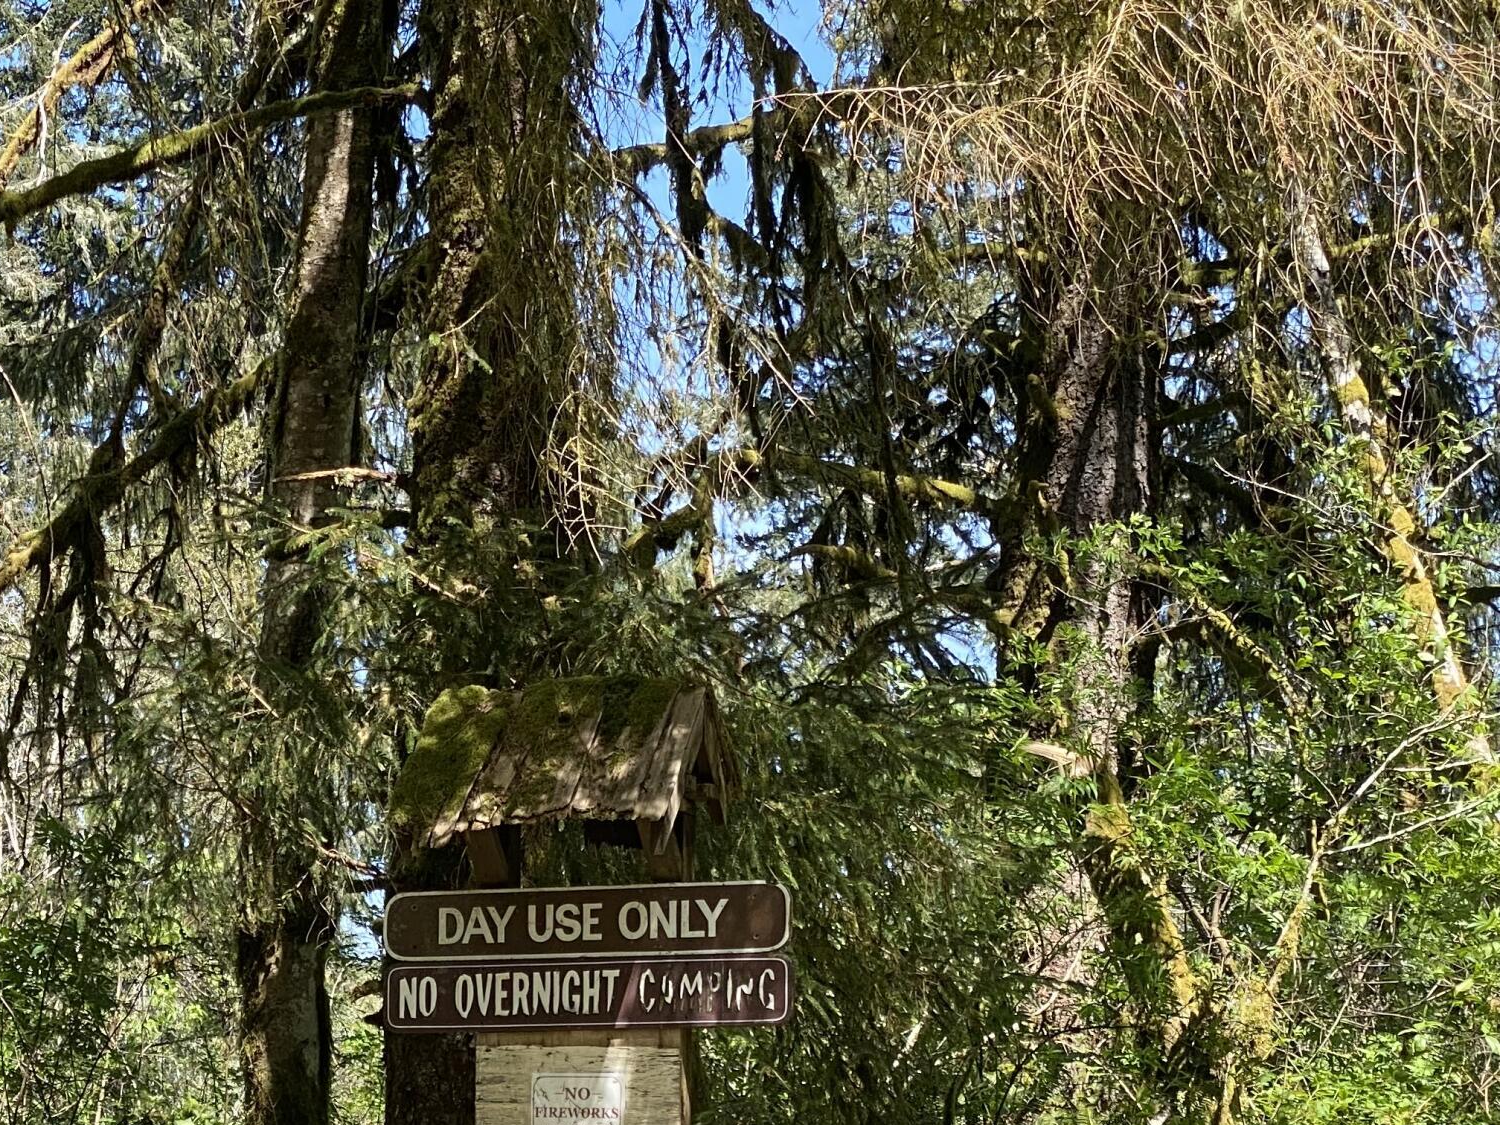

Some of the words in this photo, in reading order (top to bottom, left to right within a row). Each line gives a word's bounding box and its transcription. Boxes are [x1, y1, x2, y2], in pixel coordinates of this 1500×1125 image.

[438, 905, 516, 945] DAY
[527, 903, 603, 943] USE
[618, 898, 729, 940] ONLY
[399, 976, 437, 1019] NO
[455, 969, 620, 1018] OVERNIGHT
[564, 1087, 591, 1101] NO
[535, 1106, 619, 1119] FIREWORKS
